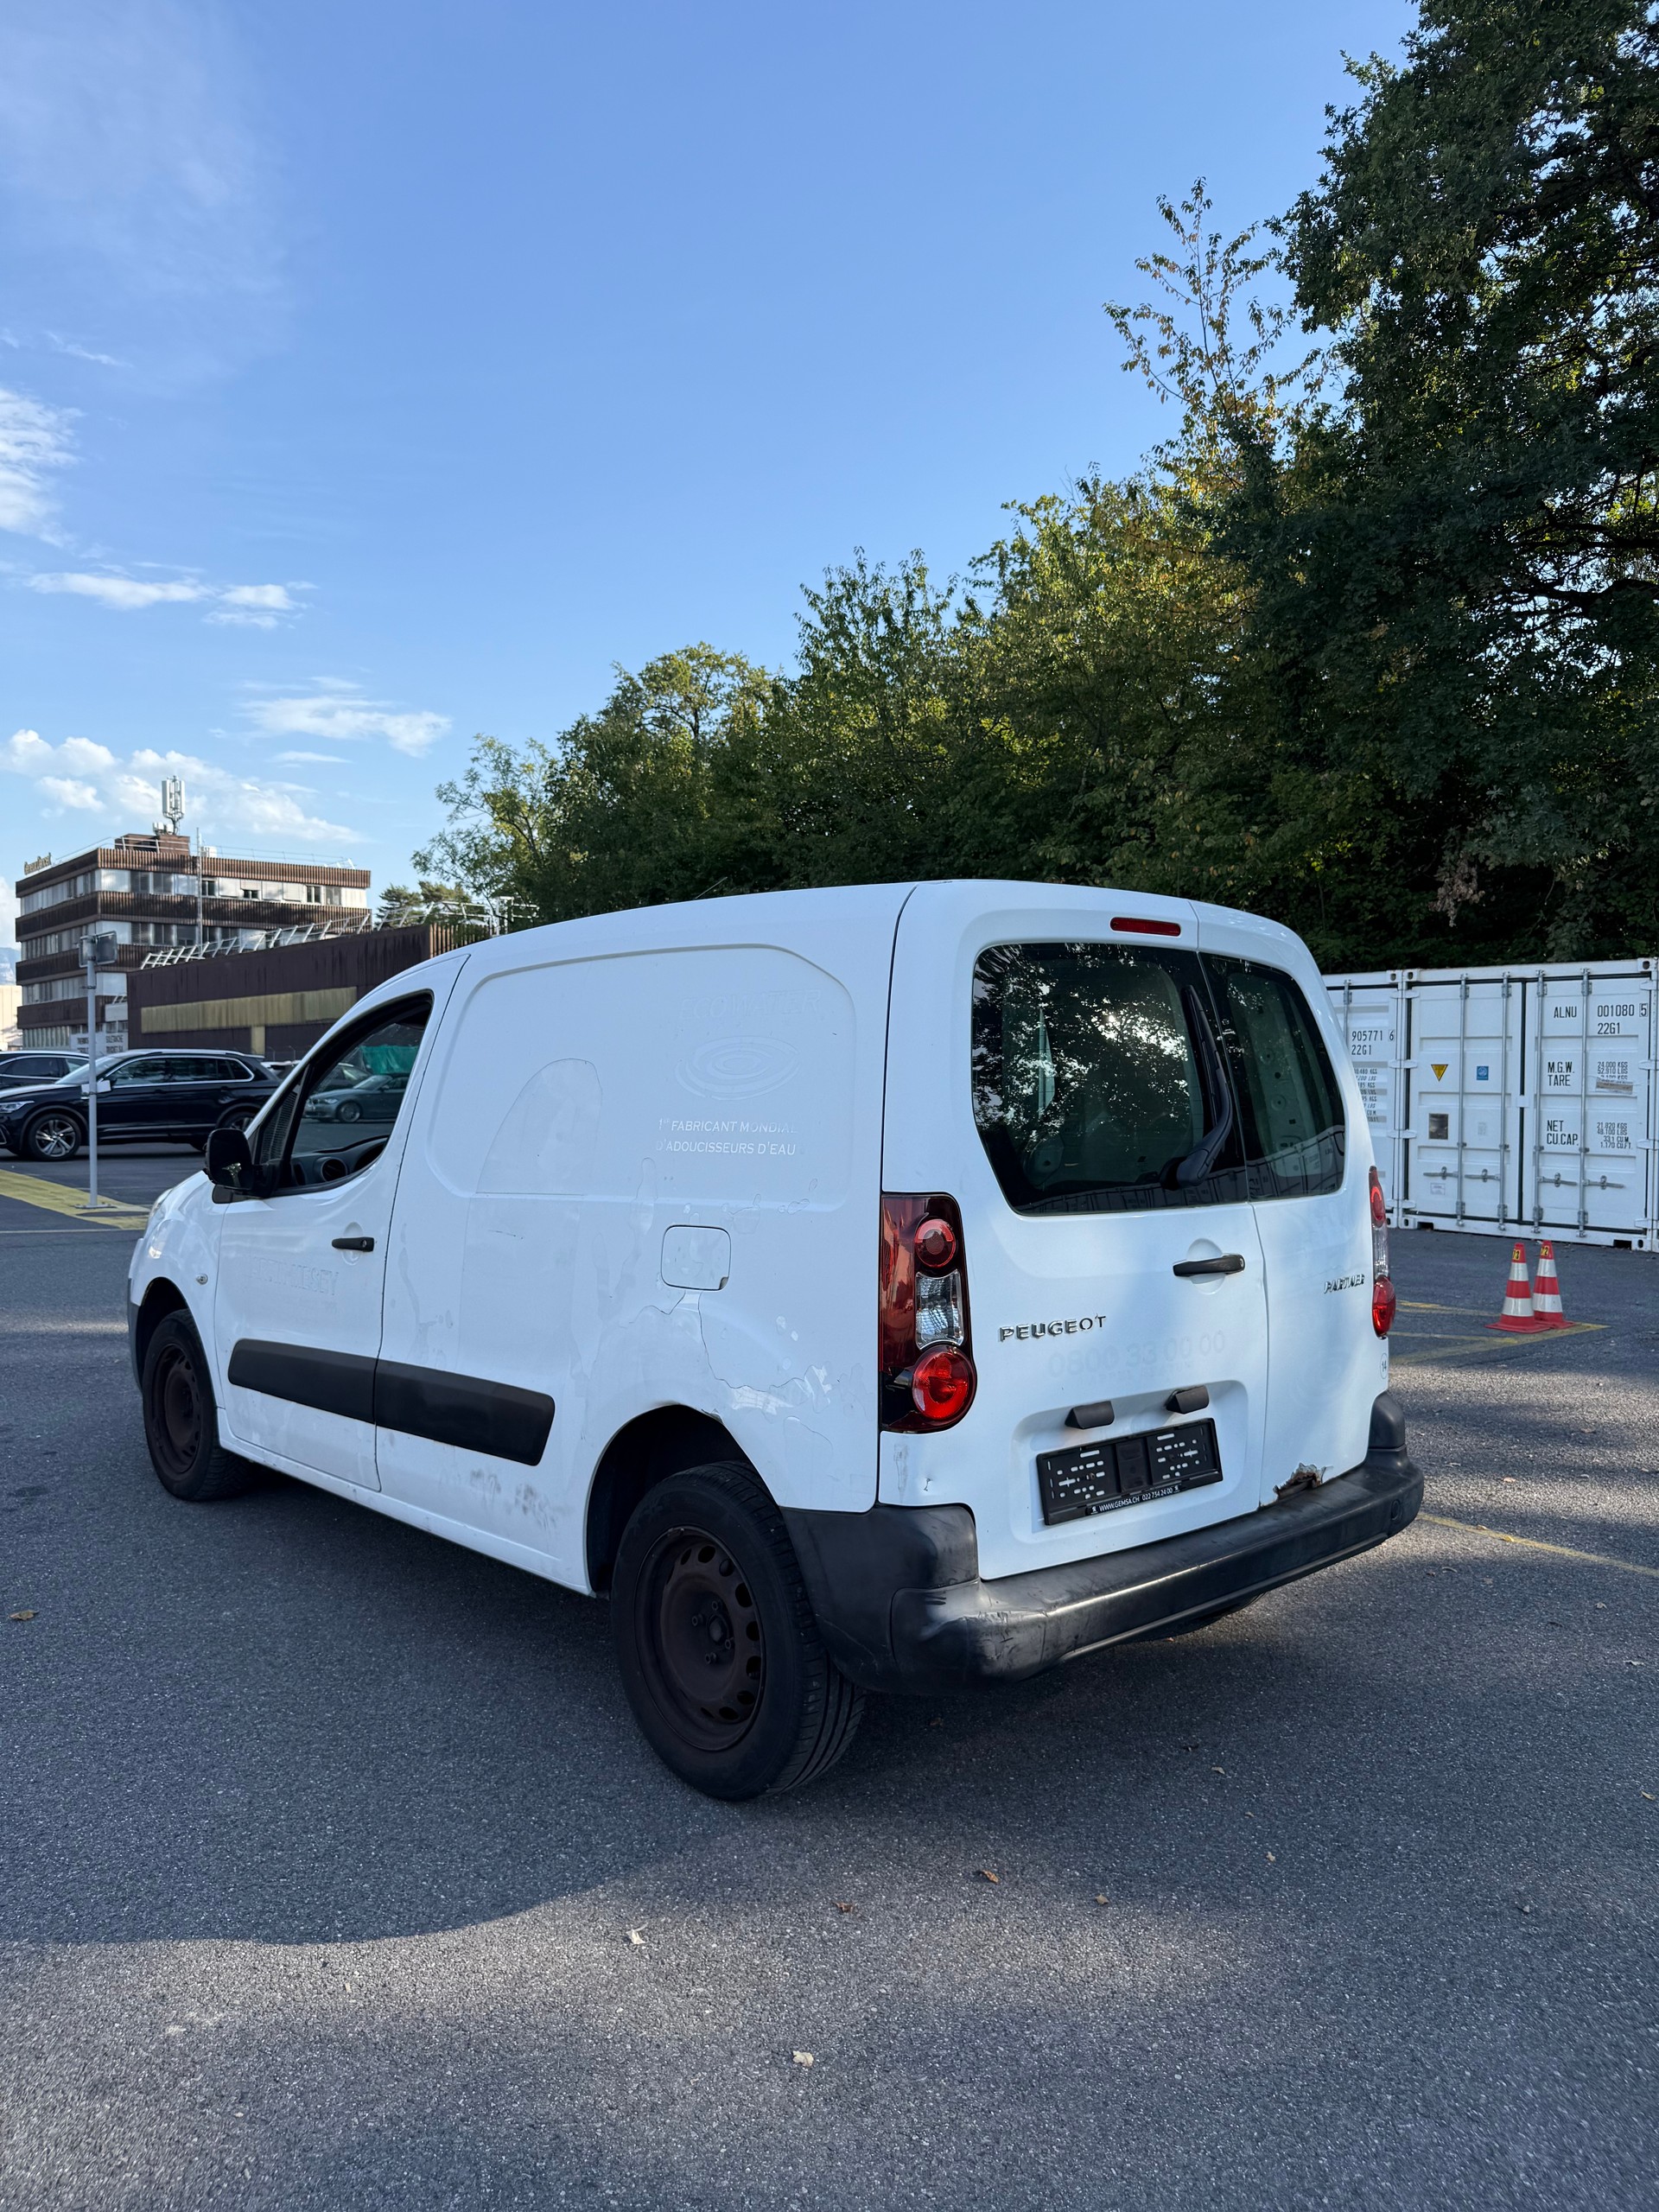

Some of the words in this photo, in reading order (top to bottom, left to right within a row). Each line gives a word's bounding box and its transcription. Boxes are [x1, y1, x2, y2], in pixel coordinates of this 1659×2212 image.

[1554, 1006, 1577, 1018] ALNU
[1597, 1004, 1635, 1017] 001080
[1640, 1003, 1647, 1016] 5
[1597, 1022, 1620, 1034] 22G1
[1351, 1030, 1382, 1041] 905771
[1389, 1030, 1395, 1041] 6
[1351, 1045, 1371, 1055] 22G1
[1548, 1061, 1574, 1073] M.G.W.
[1548, 1075, 1571, 1086] TARE
[671, 1121, 737, 1132] FABRICANT
[1547, 1120, 1564, 1132] NET
[1547, 1133, 1580, 1146] CU.CAP.
[656, 1139, 754, 1154] D'ADOUCISSEURS
[758, 1141, 797, 1155] D'EAU
[1324, 1274, 1365, 1294] PARTNER
[999, 1315, 1106, 1342] PEUGEOT
[1099, 1496, 1140, 1512] WWW.GEMSA.CH
[1141, 1492, 1151, 1501] 022
